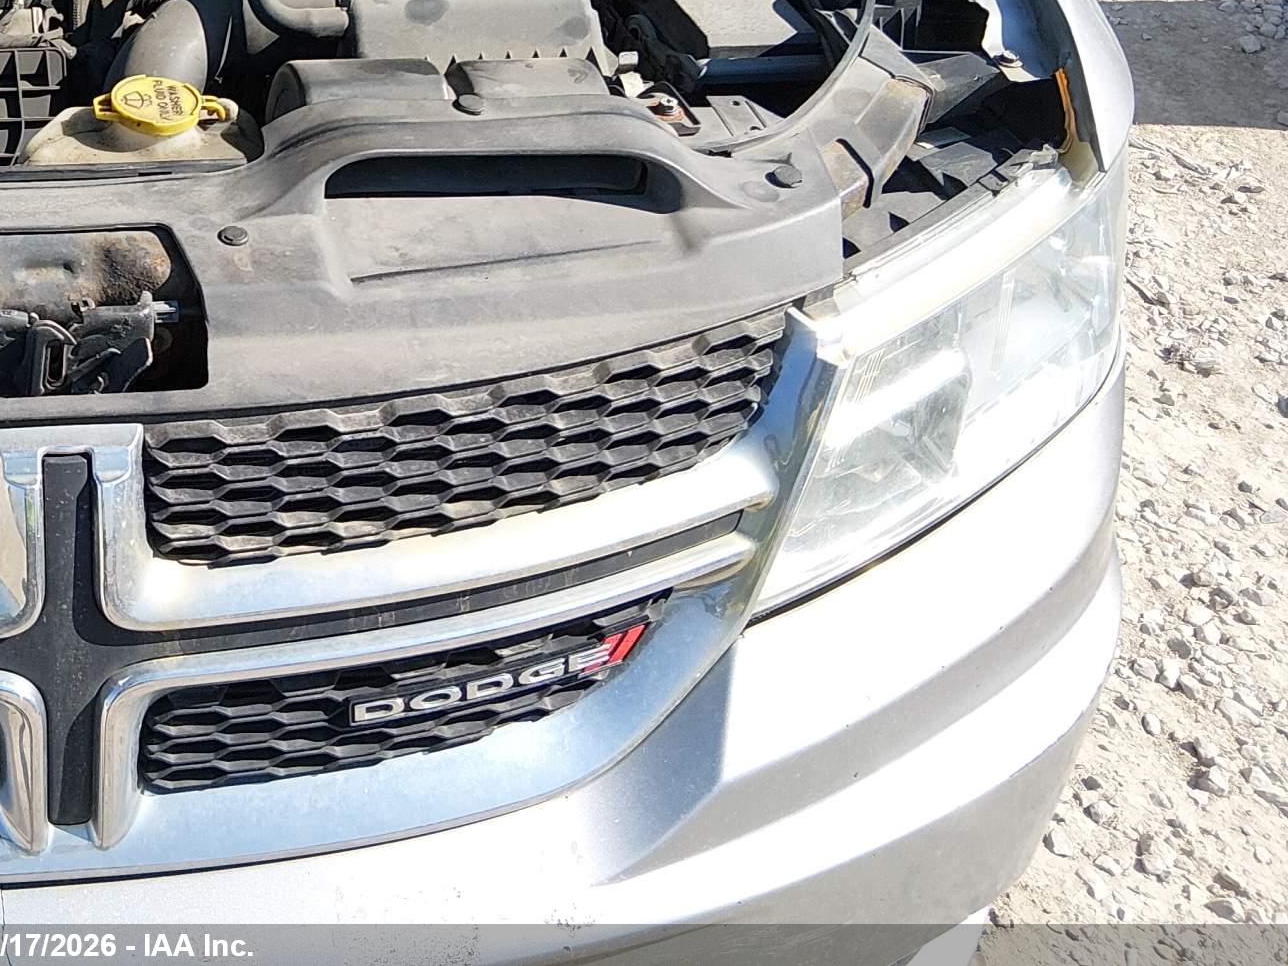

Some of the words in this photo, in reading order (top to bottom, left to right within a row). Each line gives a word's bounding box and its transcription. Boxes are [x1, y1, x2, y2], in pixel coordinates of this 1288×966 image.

[152, 79, 167, 101] FLUID
[166, 85, 183, 116] WASHER
[157, 101, 173, 121] ONLY
[353, 642, 611, 723] DODGE
